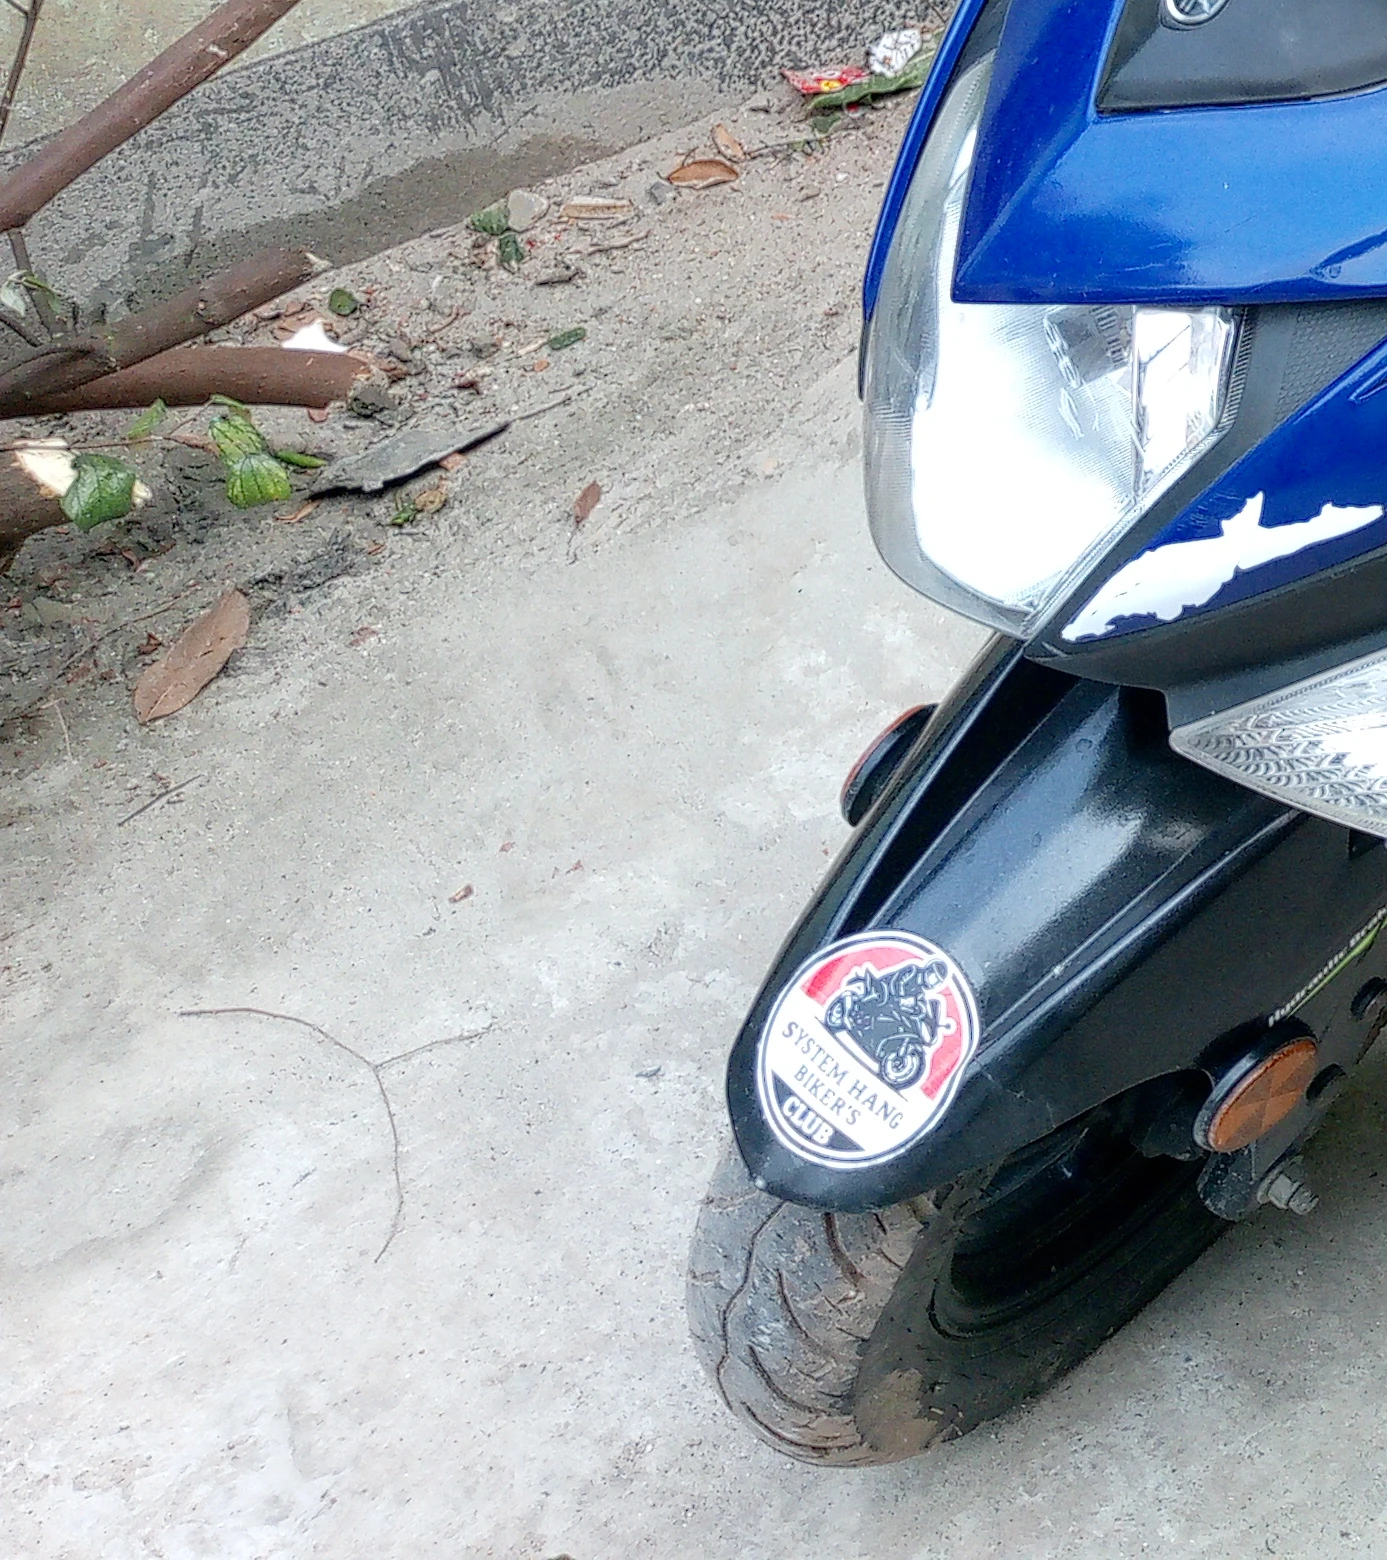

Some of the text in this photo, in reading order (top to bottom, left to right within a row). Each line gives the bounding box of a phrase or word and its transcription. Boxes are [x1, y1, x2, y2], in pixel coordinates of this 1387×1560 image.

[781, 1021, 904, 1130] SYSTEM HANG
[793, 1064, 862, 1126] BIKER'S
[783, 1095, 834, 1145] CLUB
